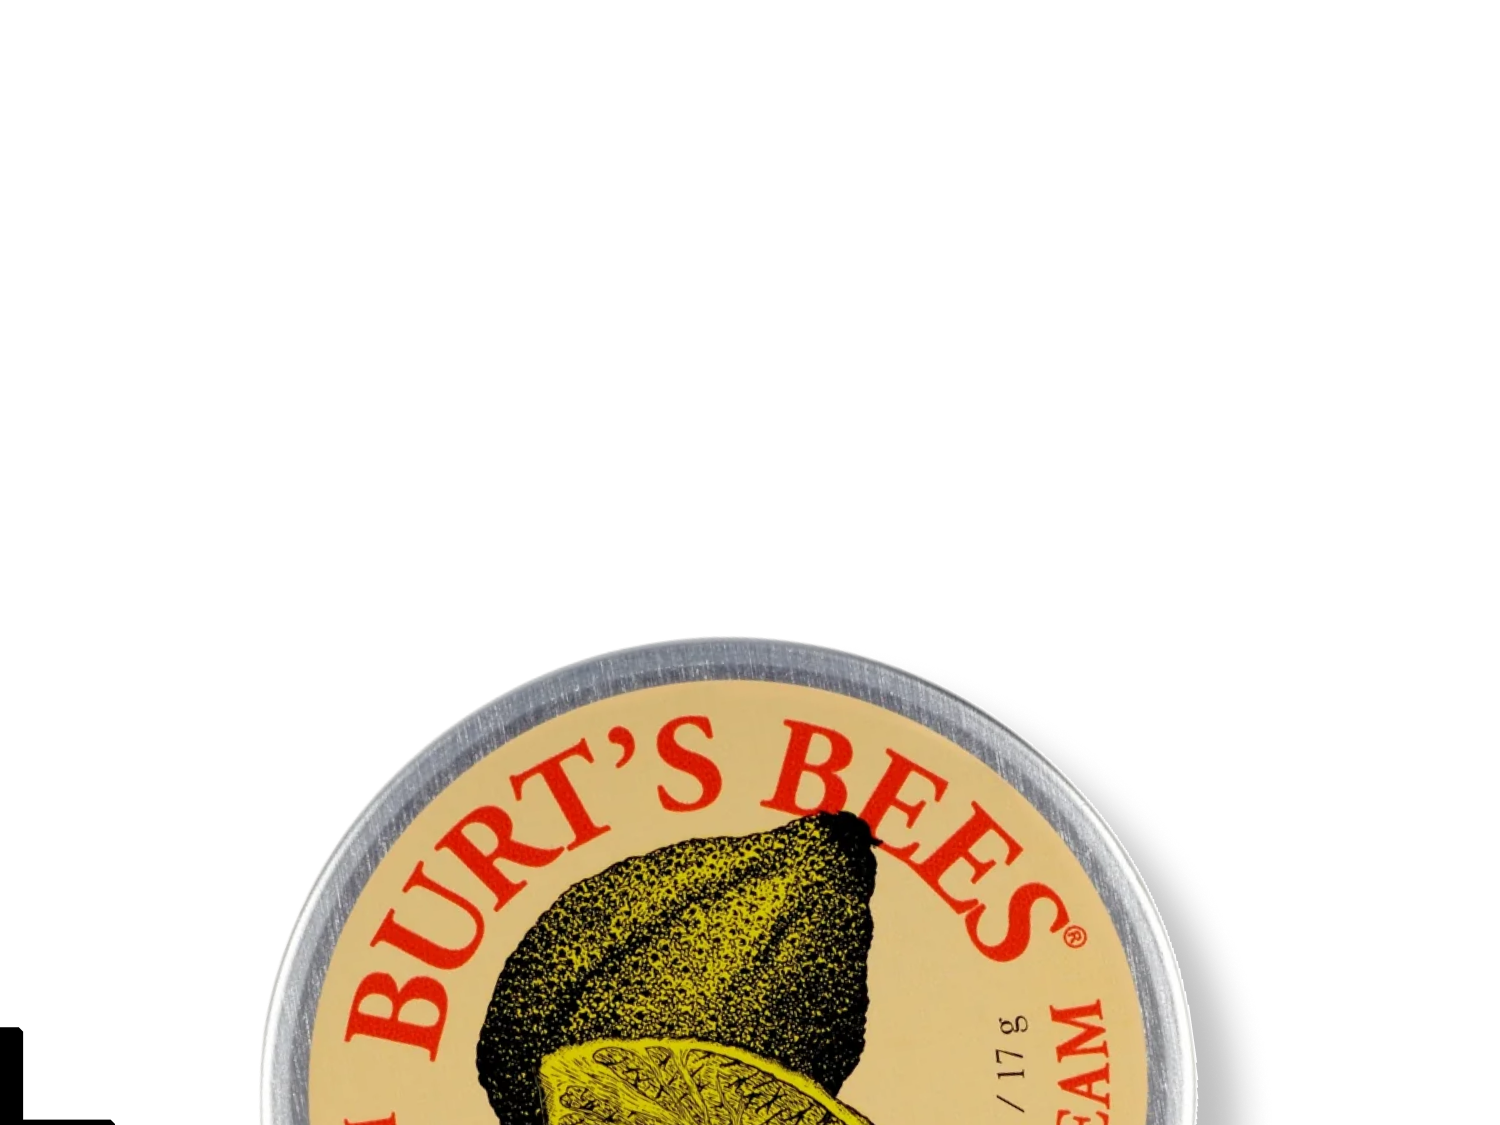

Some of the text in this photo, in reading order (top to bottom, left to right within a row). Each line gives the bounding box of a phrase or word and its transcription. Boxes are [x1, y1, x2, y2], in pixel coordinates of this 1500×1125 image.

[344, 714, 722, 1063] BURT’S
[999, 1014, 1028, 1035] g
[996, 1046, 1026, 1080] 17
[996, 1094, 1026, 1114] /
